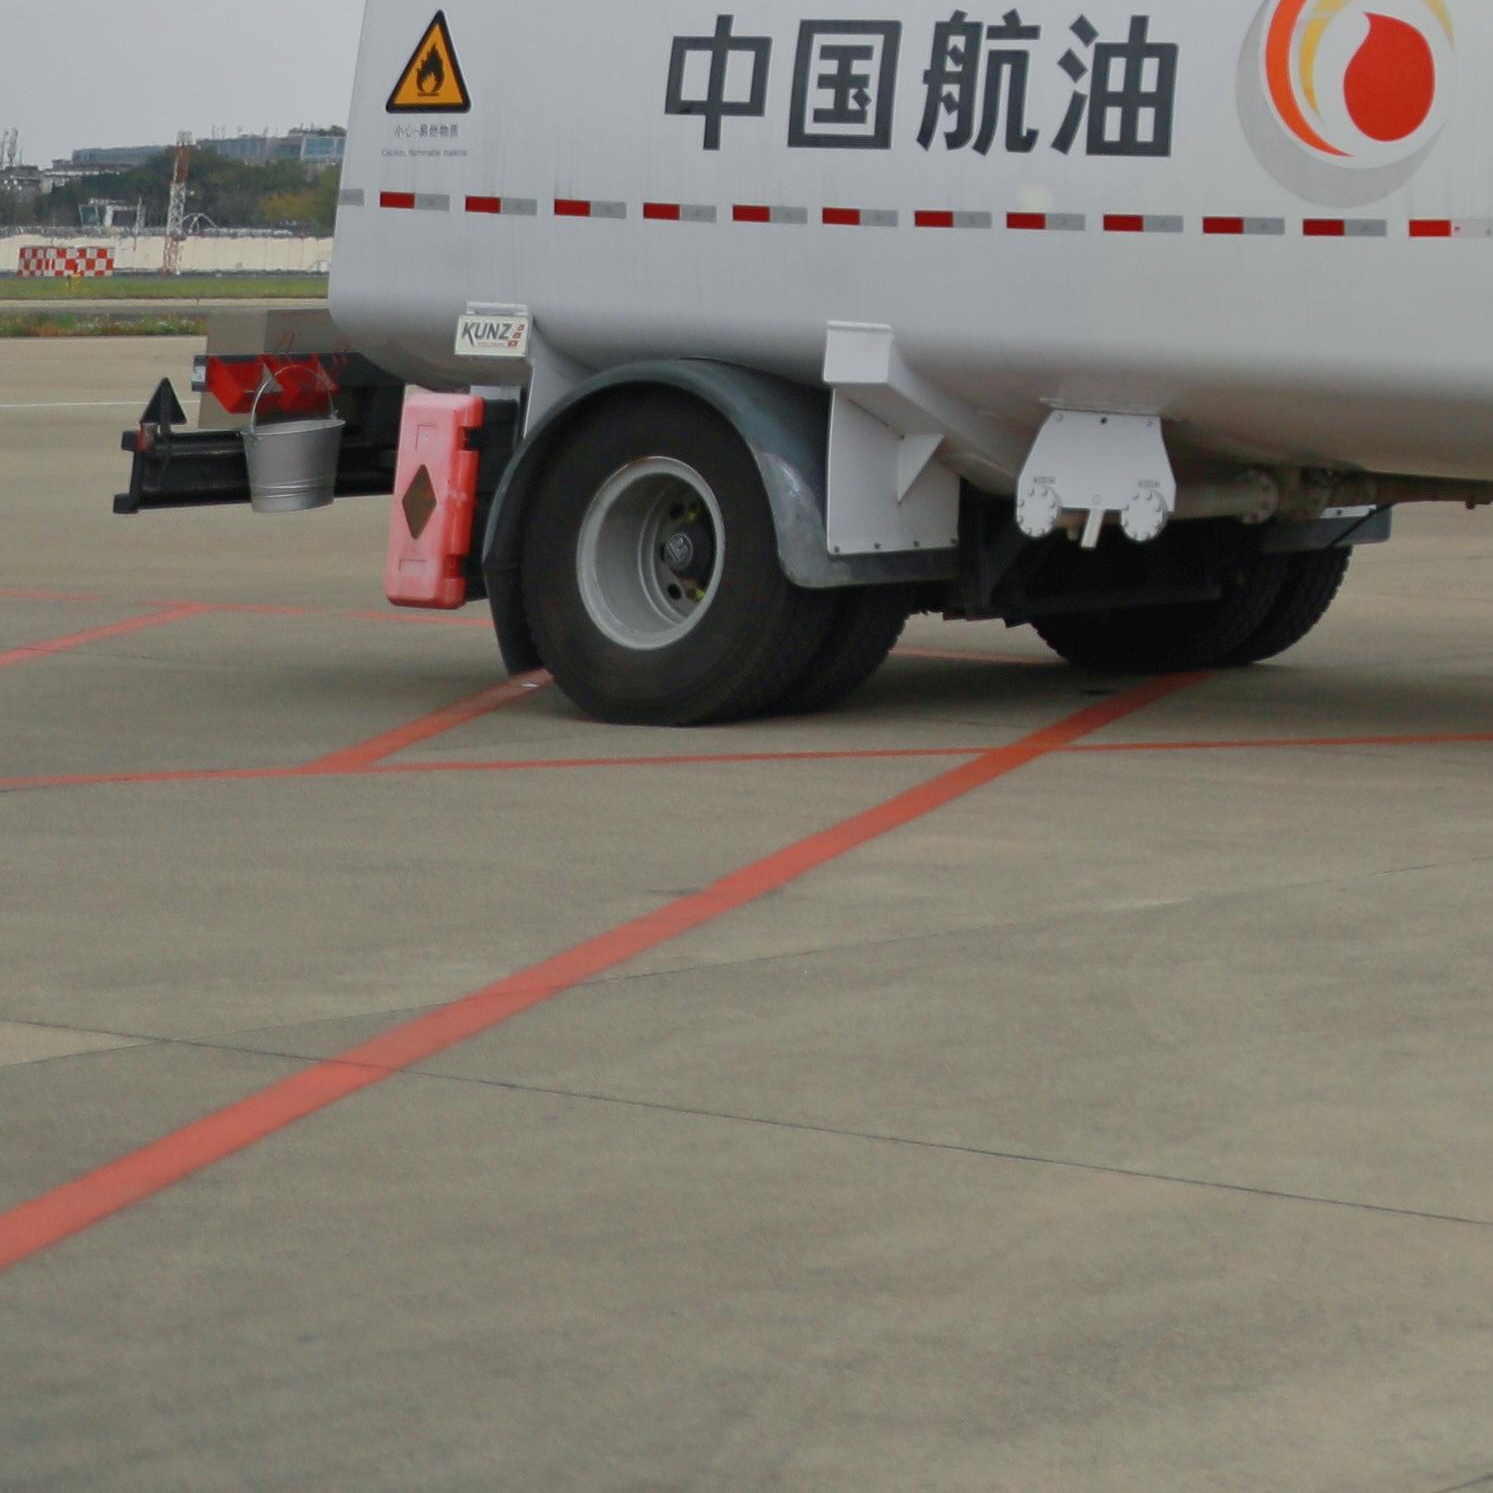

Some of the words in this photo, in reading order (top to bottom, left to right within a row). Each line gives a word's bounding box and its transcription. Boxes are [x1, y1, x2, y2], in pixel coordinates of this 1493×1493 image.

[663, 9, 1178, 158] 中国航油
[462, 321, 513, 346] KUNZ
